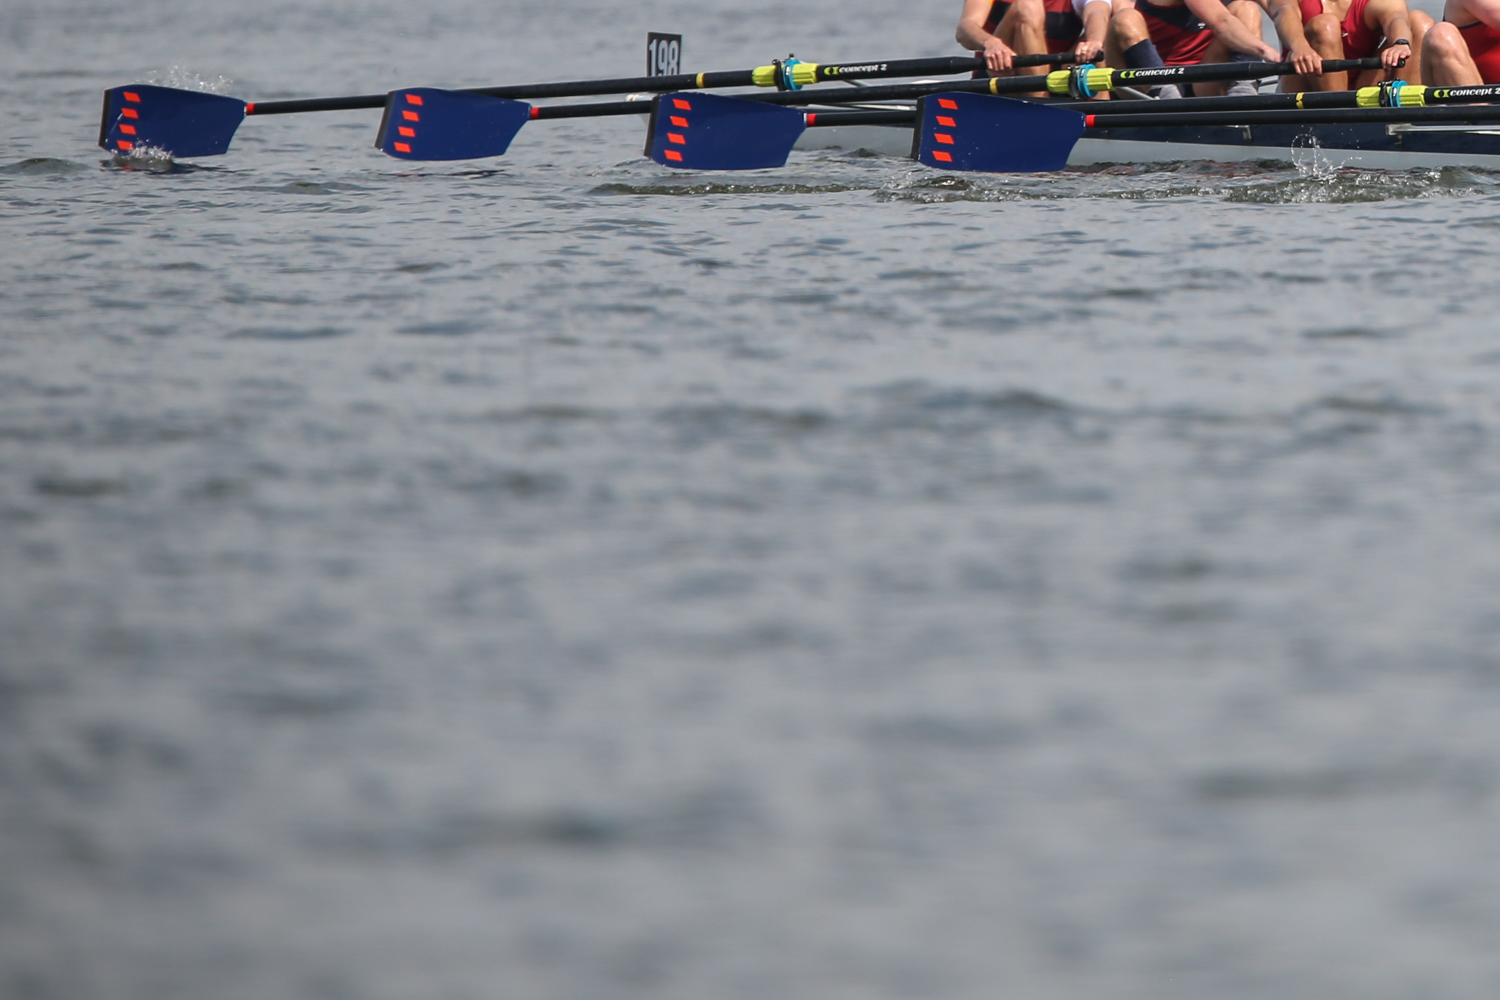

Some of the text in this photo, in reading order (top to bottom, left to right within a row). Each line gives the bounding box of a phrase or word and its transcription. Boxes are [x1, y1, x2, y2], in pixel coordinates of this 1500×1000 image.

[649, 39, 679, 77] 198
[880, 63, 887, 71] 2
[1135, 67, 1185, 77] concept 2
[1449, 87, 1493, 97] concept
